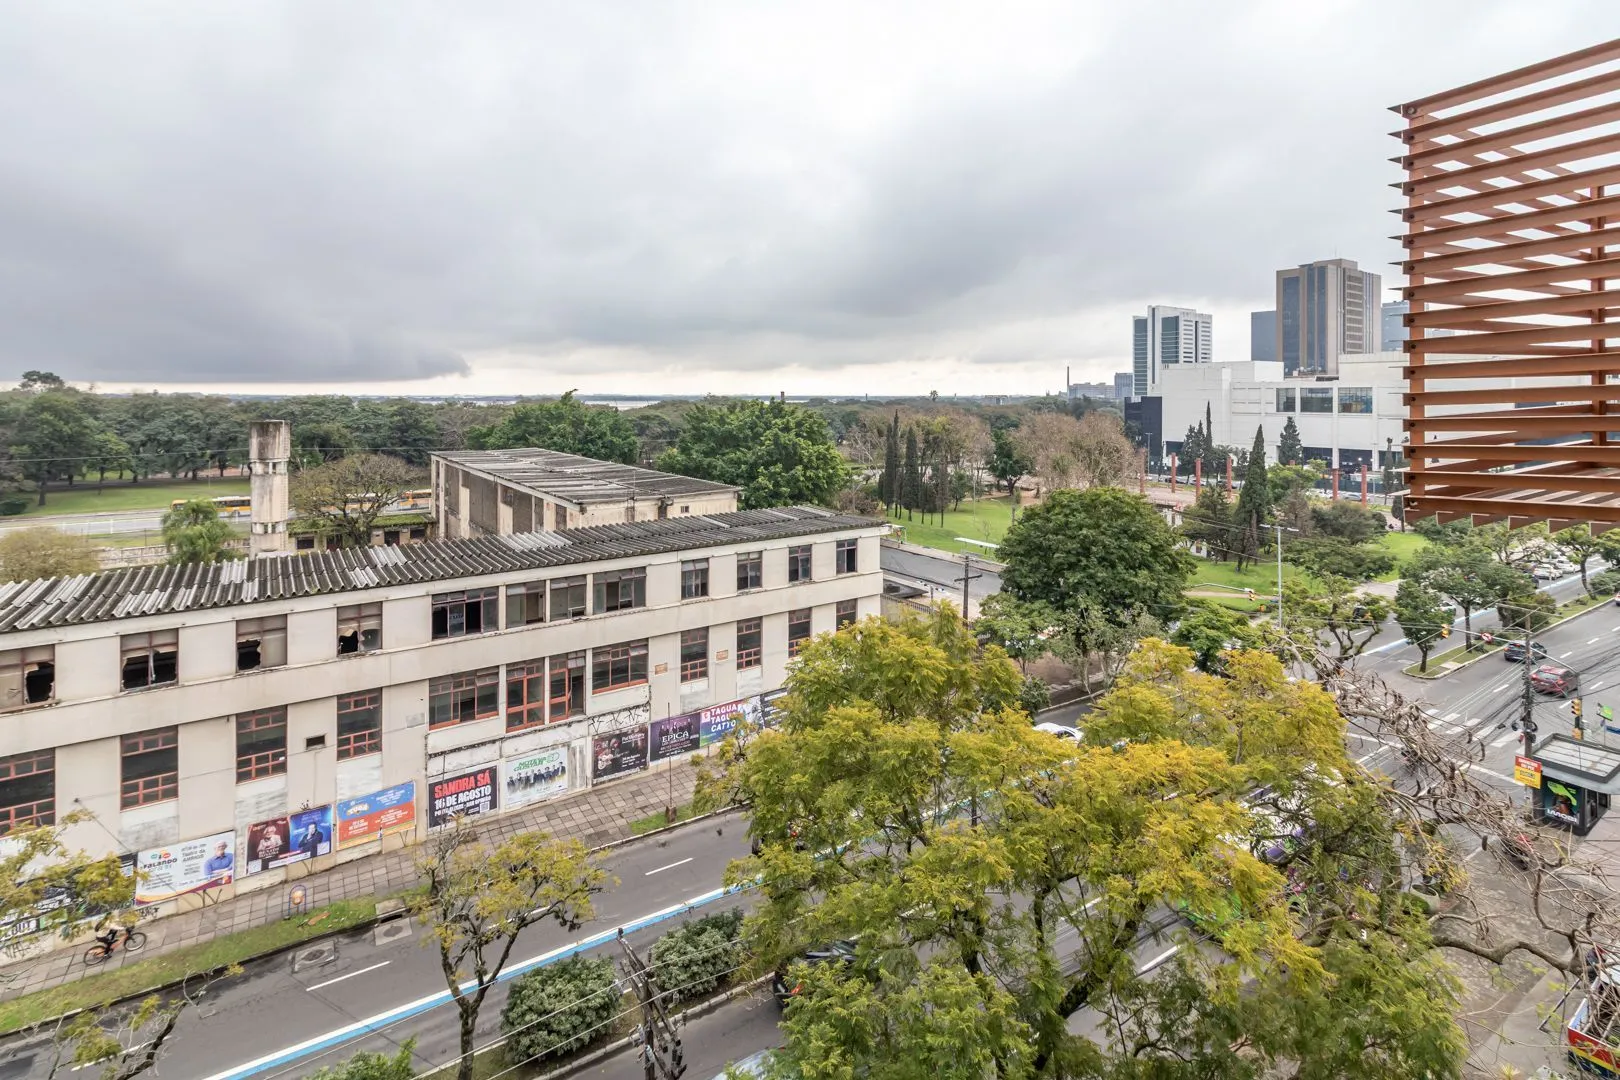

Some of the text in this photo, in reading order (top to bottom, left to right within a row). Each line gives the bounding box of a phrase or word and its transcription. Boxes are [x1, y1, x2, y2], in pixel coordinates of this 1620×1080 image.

[662, 730, 689, 742] EPICA
[434, 769, 491, 799] SANDRA SÁ
[446, 794, 458, 807] DE
[458, 784, 492, 804] AGOSTO
